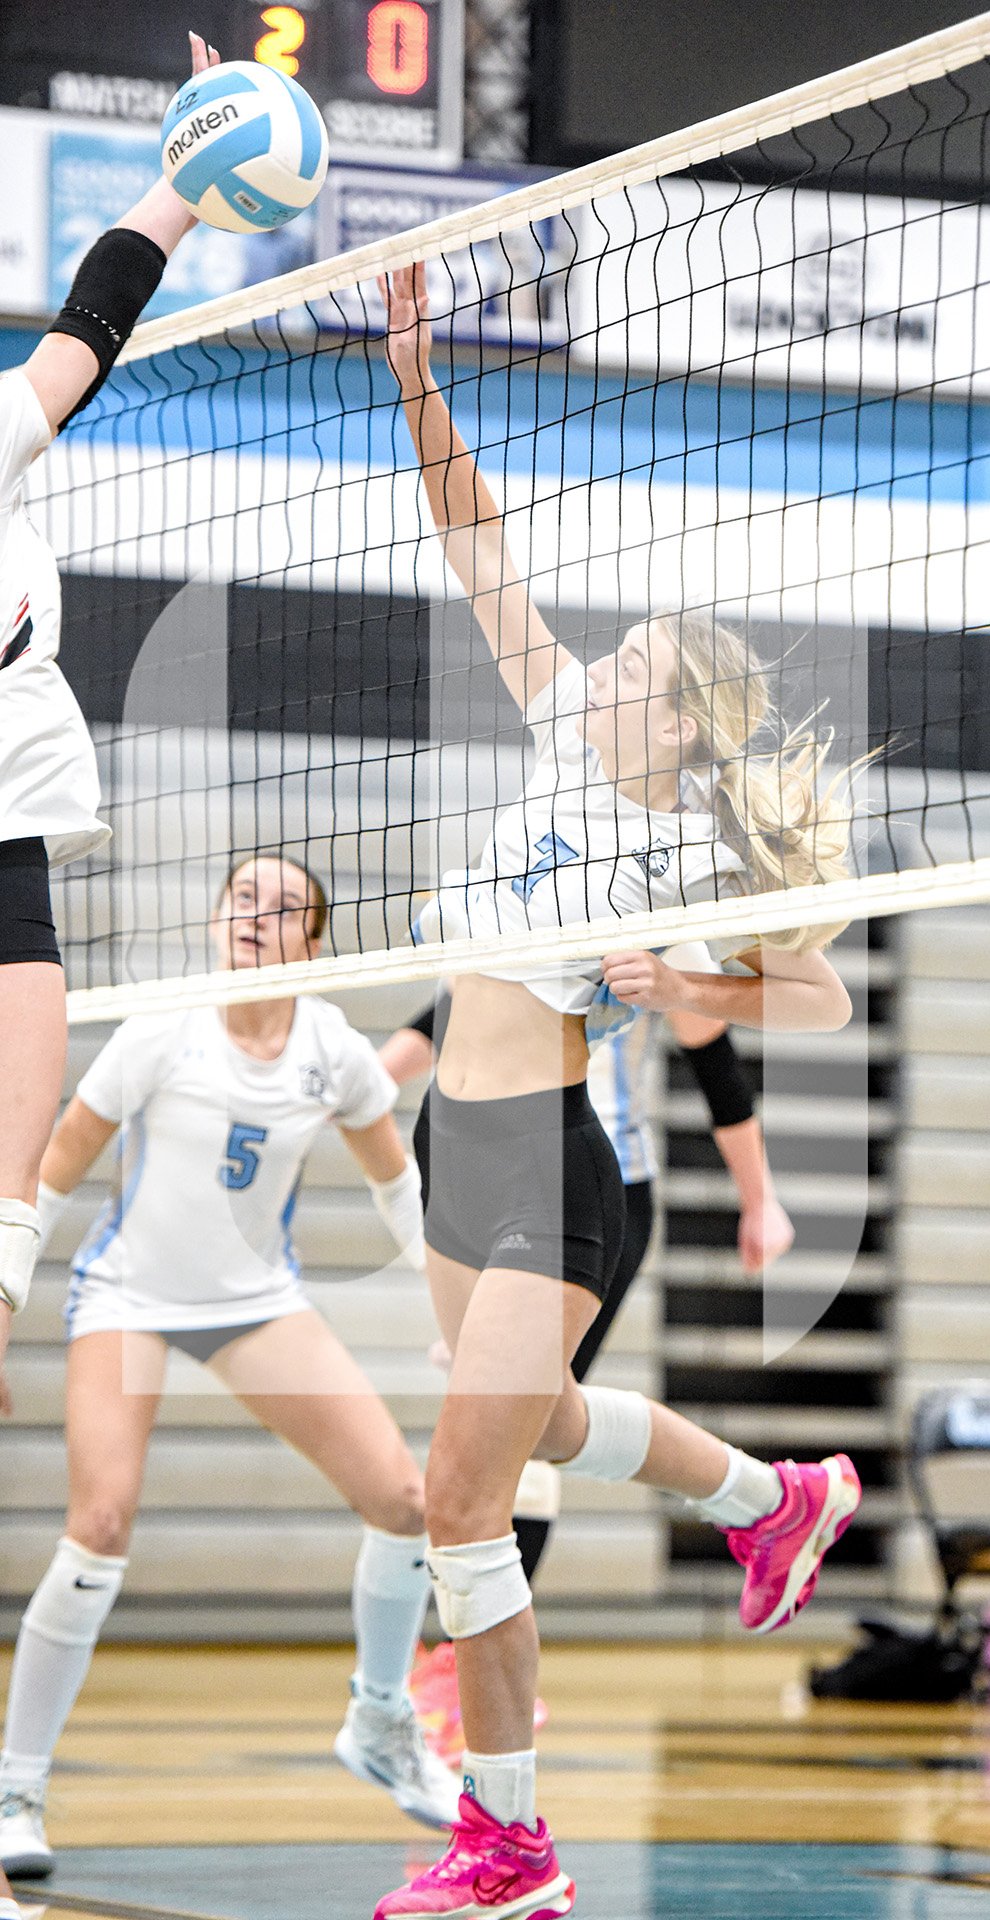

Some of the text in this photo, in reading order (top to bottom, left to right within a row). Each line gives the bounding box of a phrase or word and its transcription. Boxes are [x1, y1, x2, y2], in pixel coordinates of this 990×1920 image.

[254, 0, 429, 95] 2 0
[167, 104, 239, 166] molten
[511, 832, 579, 905] 7
[217, 1121, 268, 1190] 5
